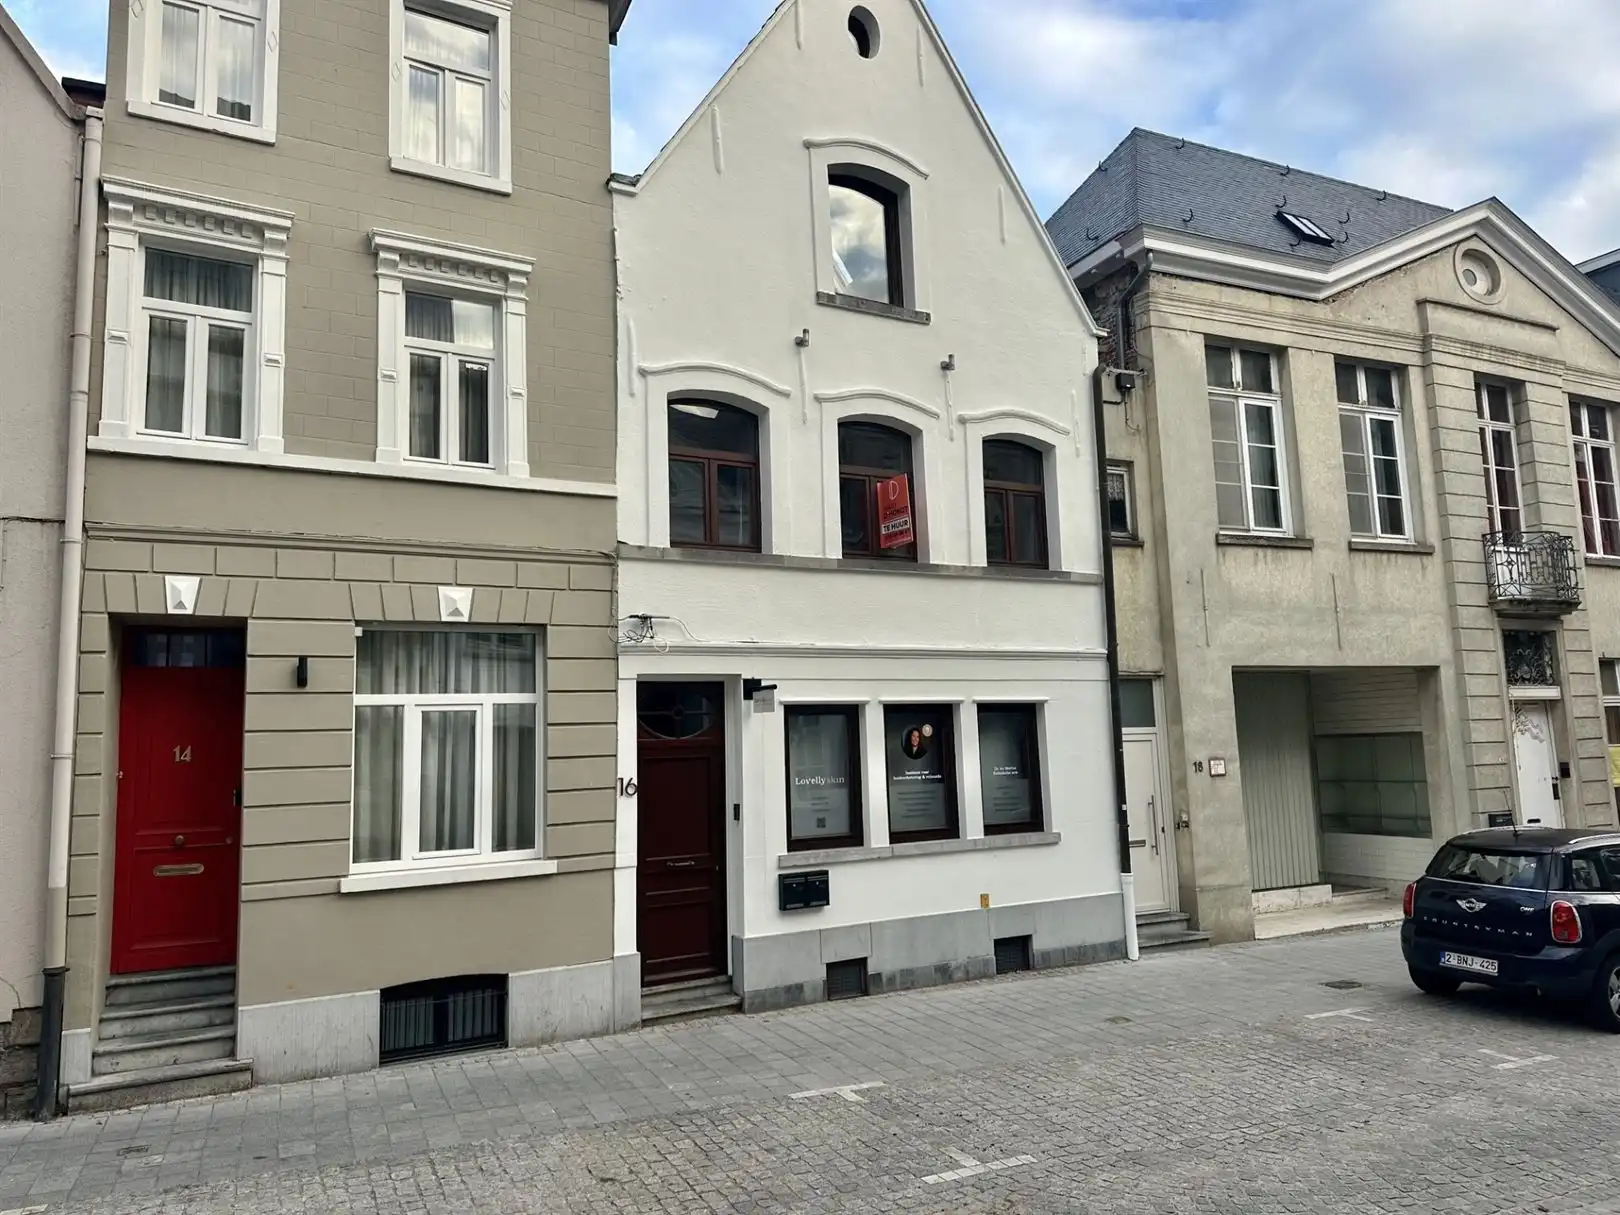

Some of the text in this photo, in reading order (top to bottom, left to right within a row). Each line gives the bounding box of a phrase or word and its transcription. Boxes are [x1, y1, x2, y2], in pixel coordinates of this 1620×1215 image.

[891, 519, 908, 530] HUUR
[173, 745, 191, 762] 14
[617, 777, 638, 797] 16
